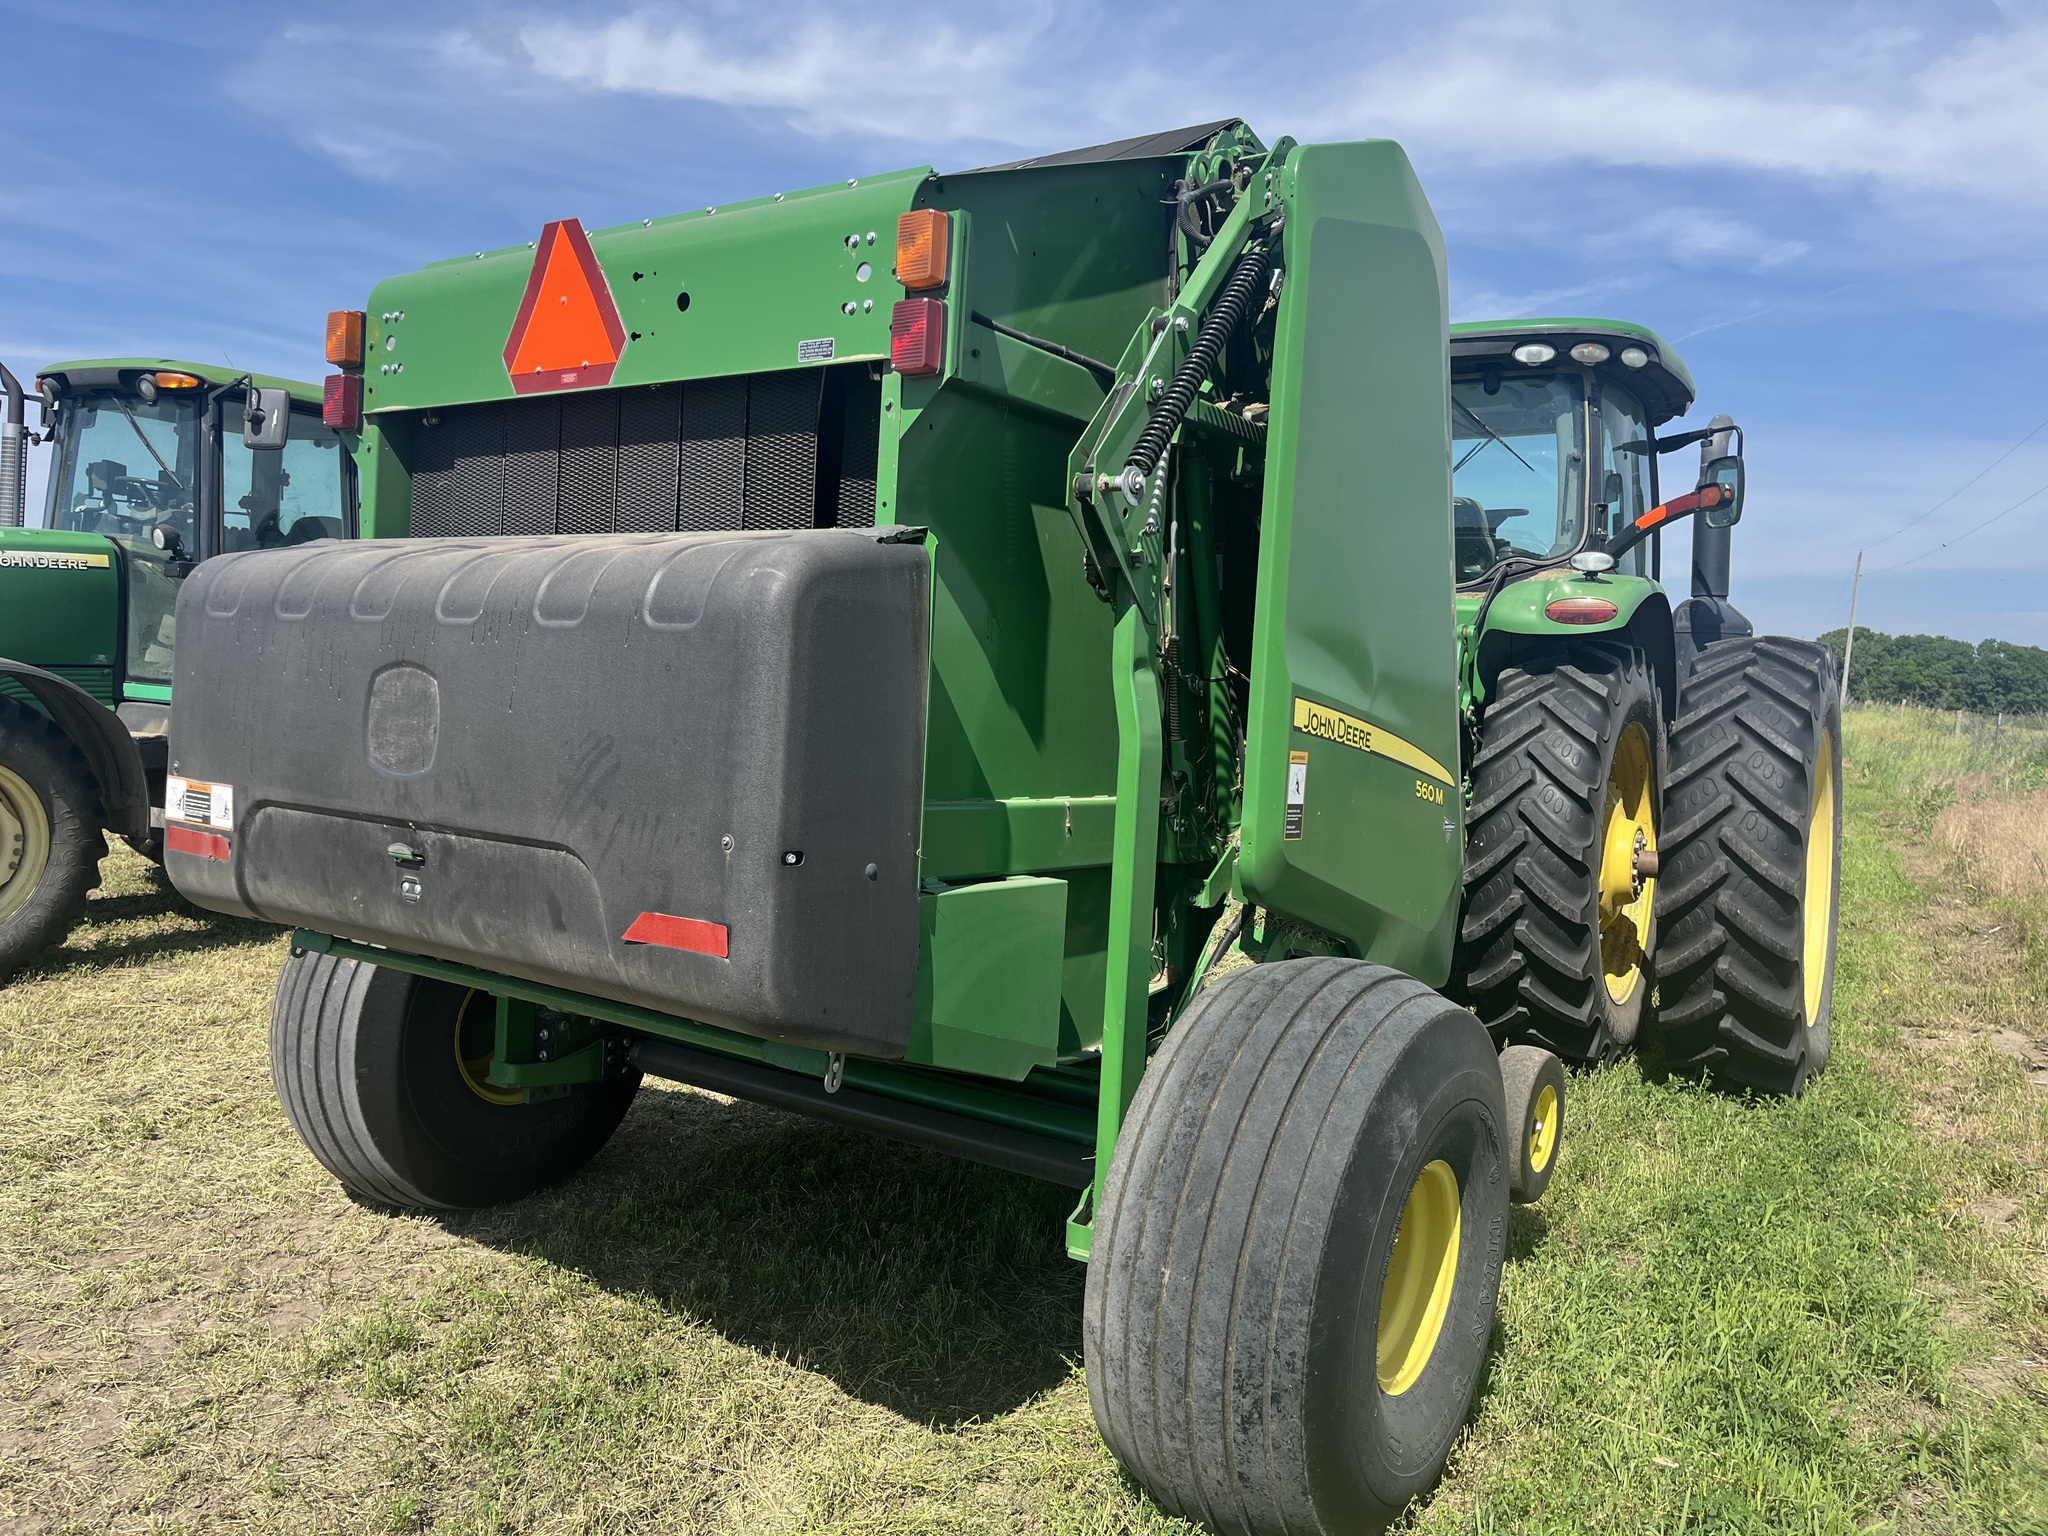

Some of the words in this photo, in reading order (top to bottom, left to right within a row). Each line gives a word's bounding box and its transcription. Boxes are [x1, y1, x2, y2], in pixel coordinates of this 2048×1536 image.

[0, 556, 34, 568] OHN
[36, 555, 88, 570] DEERE
[1303, 707, 1336, 737] JOHN
[1337, 718, 1372, 750] DEERE
